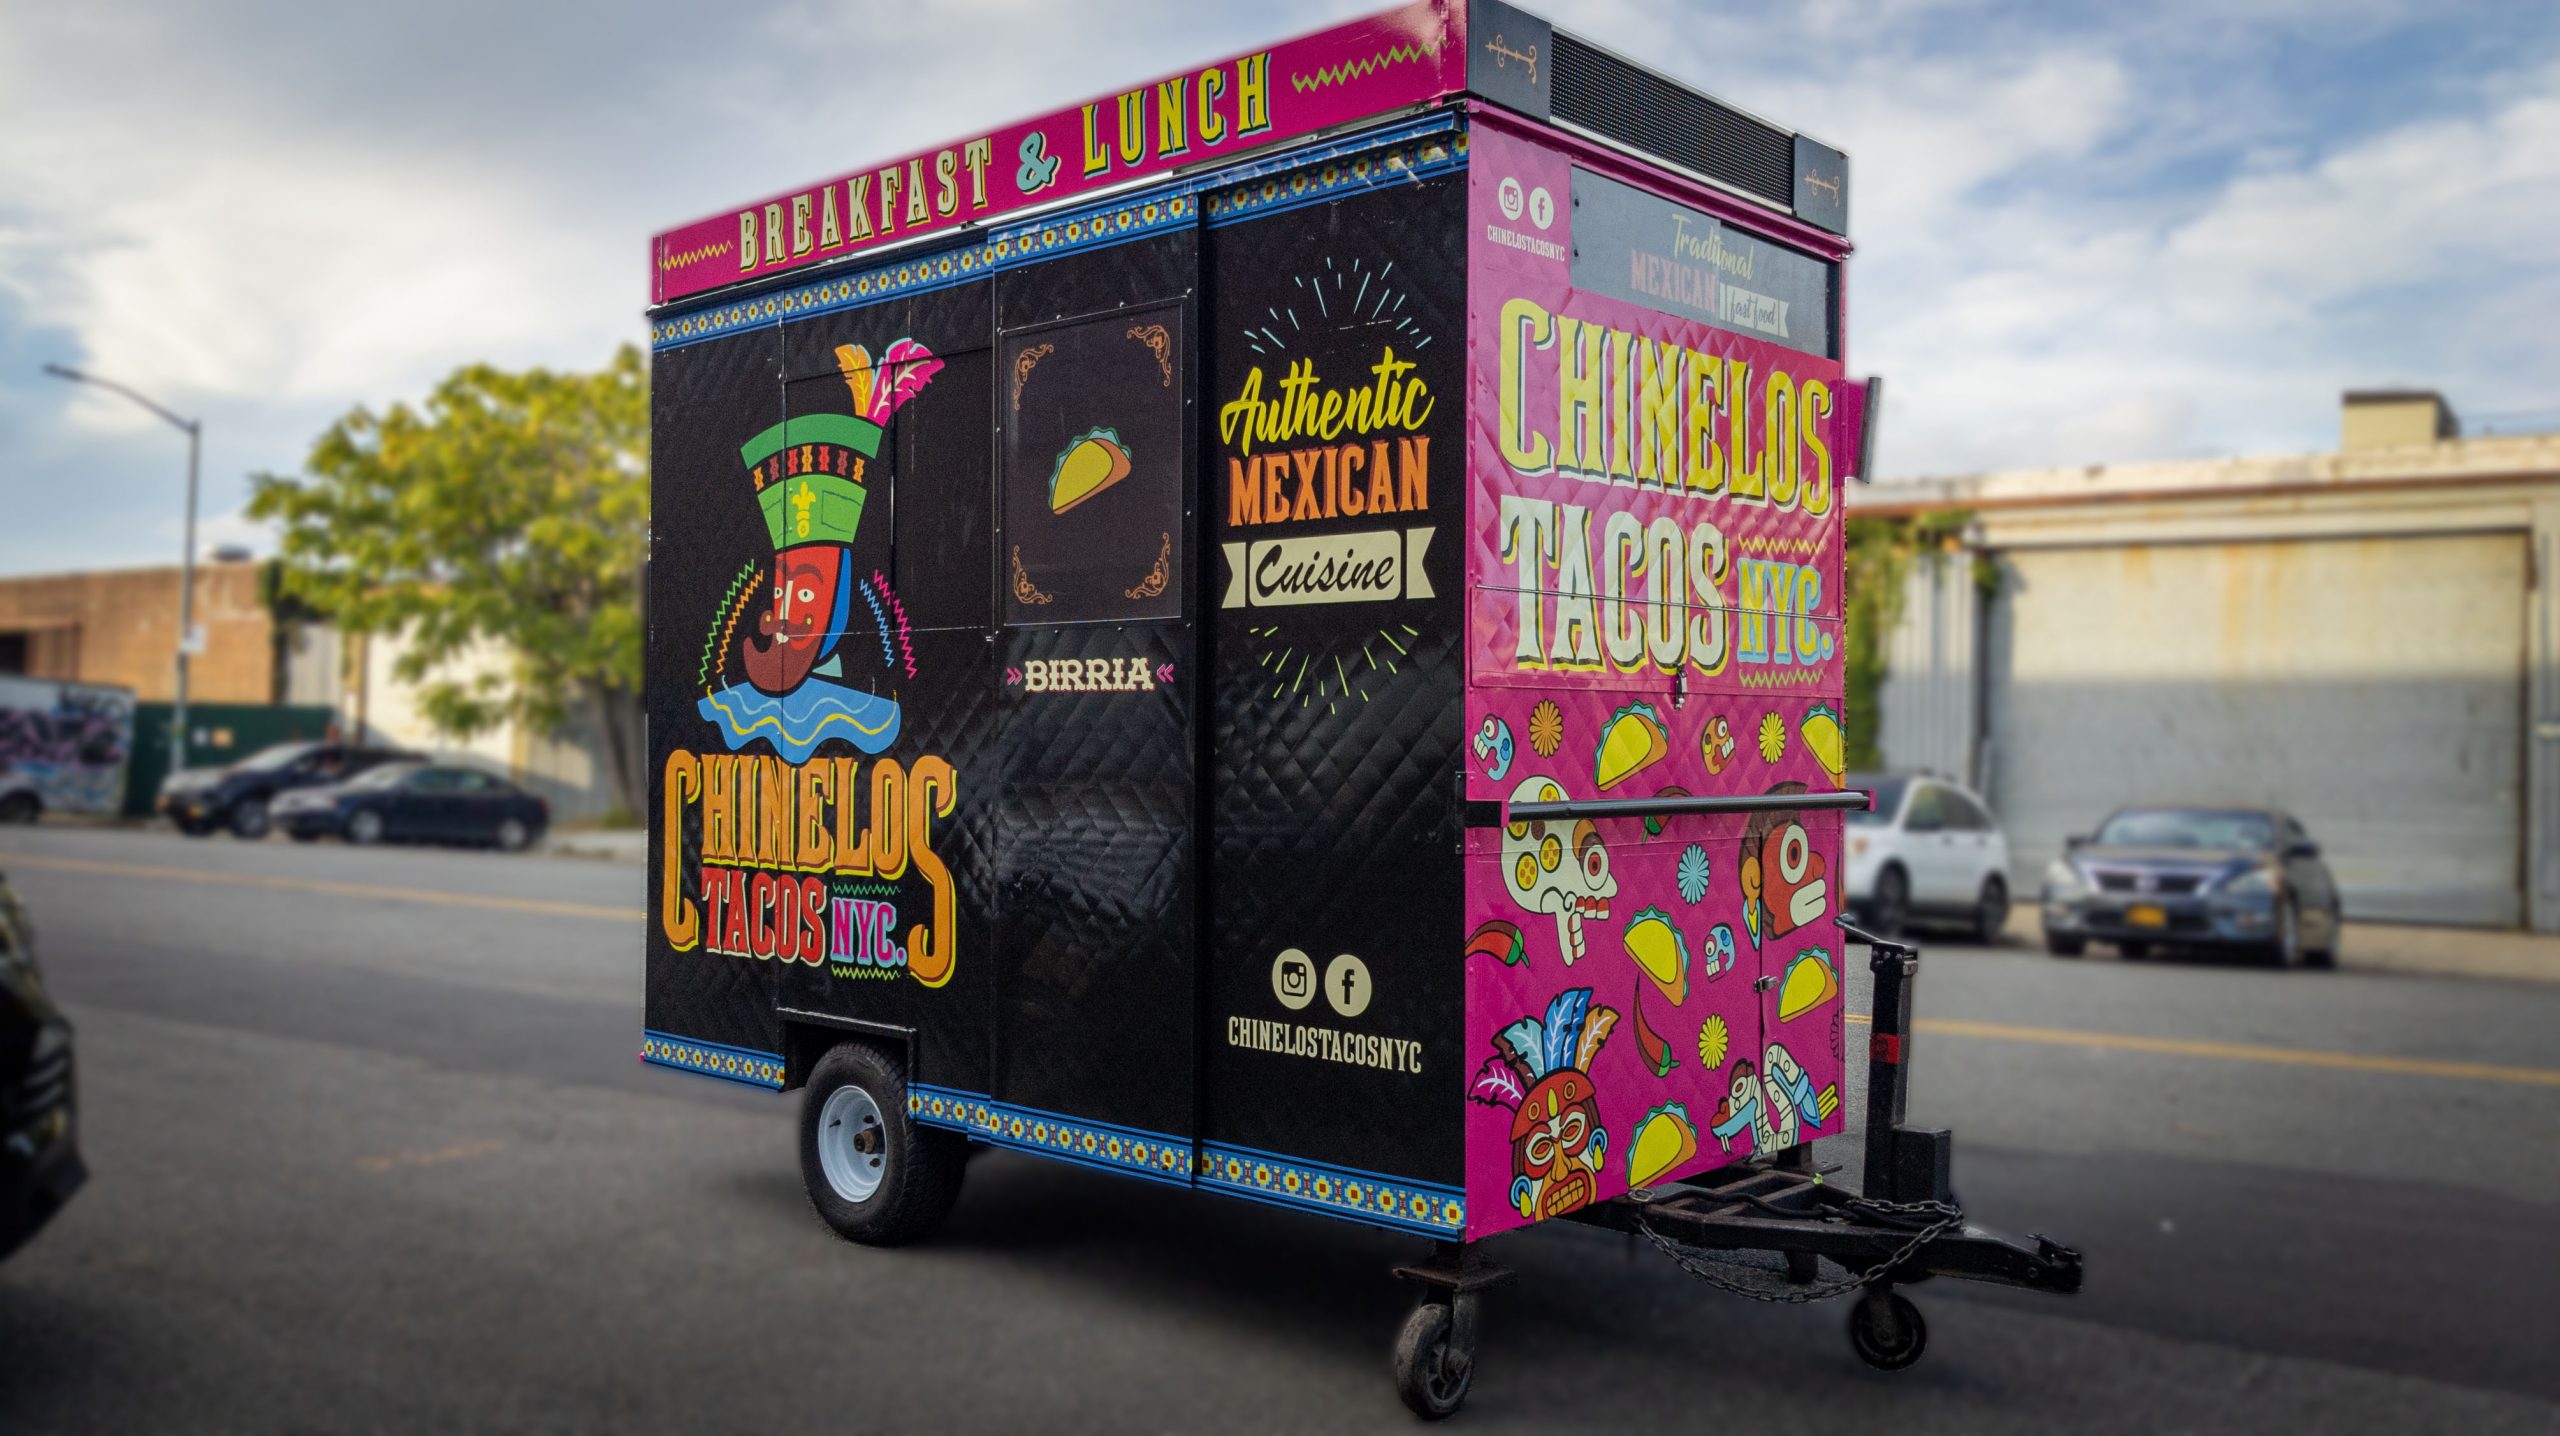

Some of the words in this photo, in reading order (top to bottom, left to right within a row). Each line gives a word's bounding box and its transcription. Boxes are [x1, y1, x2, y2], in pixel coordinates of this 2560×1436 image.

[740, 137, 992, 272] BREAKFAST
[1016, 131, 1062, 195] &
[1081, 52, 1272, 180] LUNCH
[1487, 224, 1565, 262] CHINELOSTACOSNYC
[1631, 248, 1717, 313] MEXICAN
[1730, 289, 1756, 322] fast
[1753, 296, 1776, 329] food
[1220, 346, 1435, 457] Authentic
[1500, 298, 1833, 519] CHINELOS
[1227, 435, 1431, 527] MEXICAN
[1255, 544, 1395, 598] Cuisine
[1501, 494, 1730, 676] TACOS
[1737, 557, 1834, 665] NYC.
[1024, 657, 1156, 693] BIRRIA
[662, 749, 957, 988] CHINELOS
[702, 867, 827, 967] TACOS
[830, 897, 907, 968] NYC.
[1228, 1015, 1422, 1074] CHINELOSTACOSNYC
